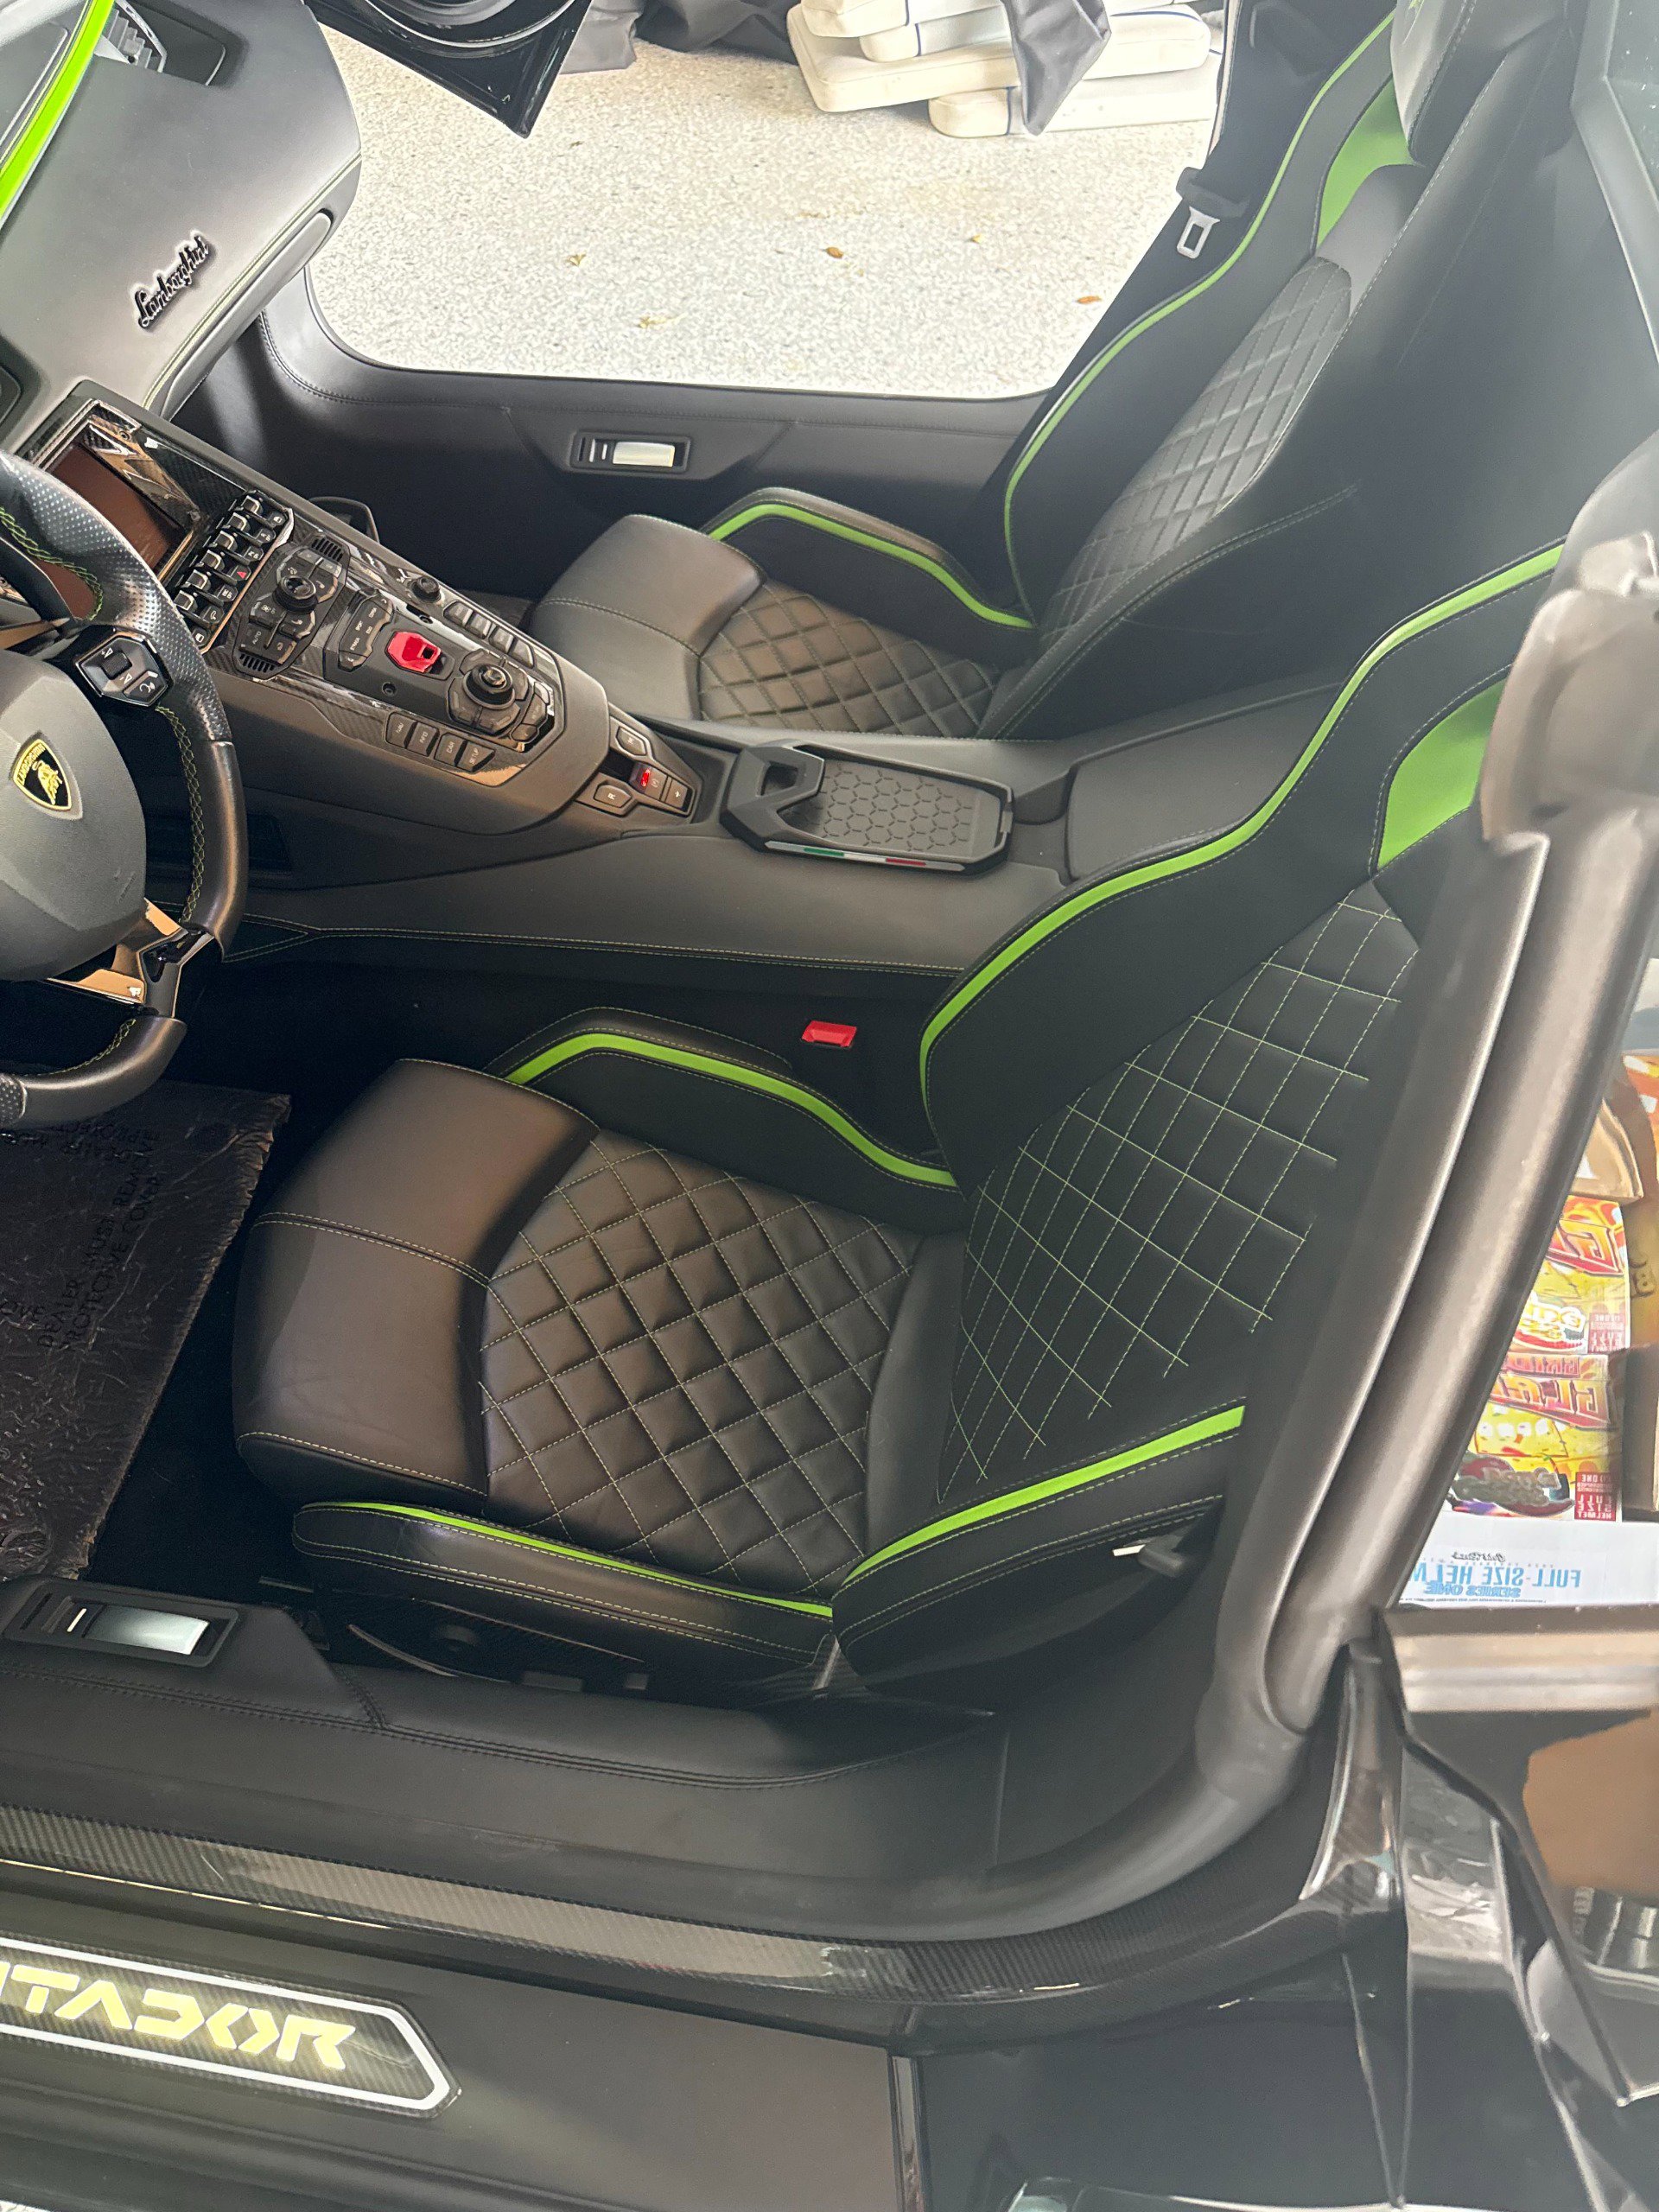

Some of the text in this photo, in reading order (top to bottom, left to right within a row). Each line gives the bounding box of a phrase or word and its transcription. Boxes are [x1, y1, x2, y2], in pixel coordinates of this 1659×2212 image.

[134, 235, 209, 328] Lamborghini
[252, 631, 262, 645] AUTO
[447, 741, 455, 753] CAR
[0, 1961, 356, 2070] TADOR
